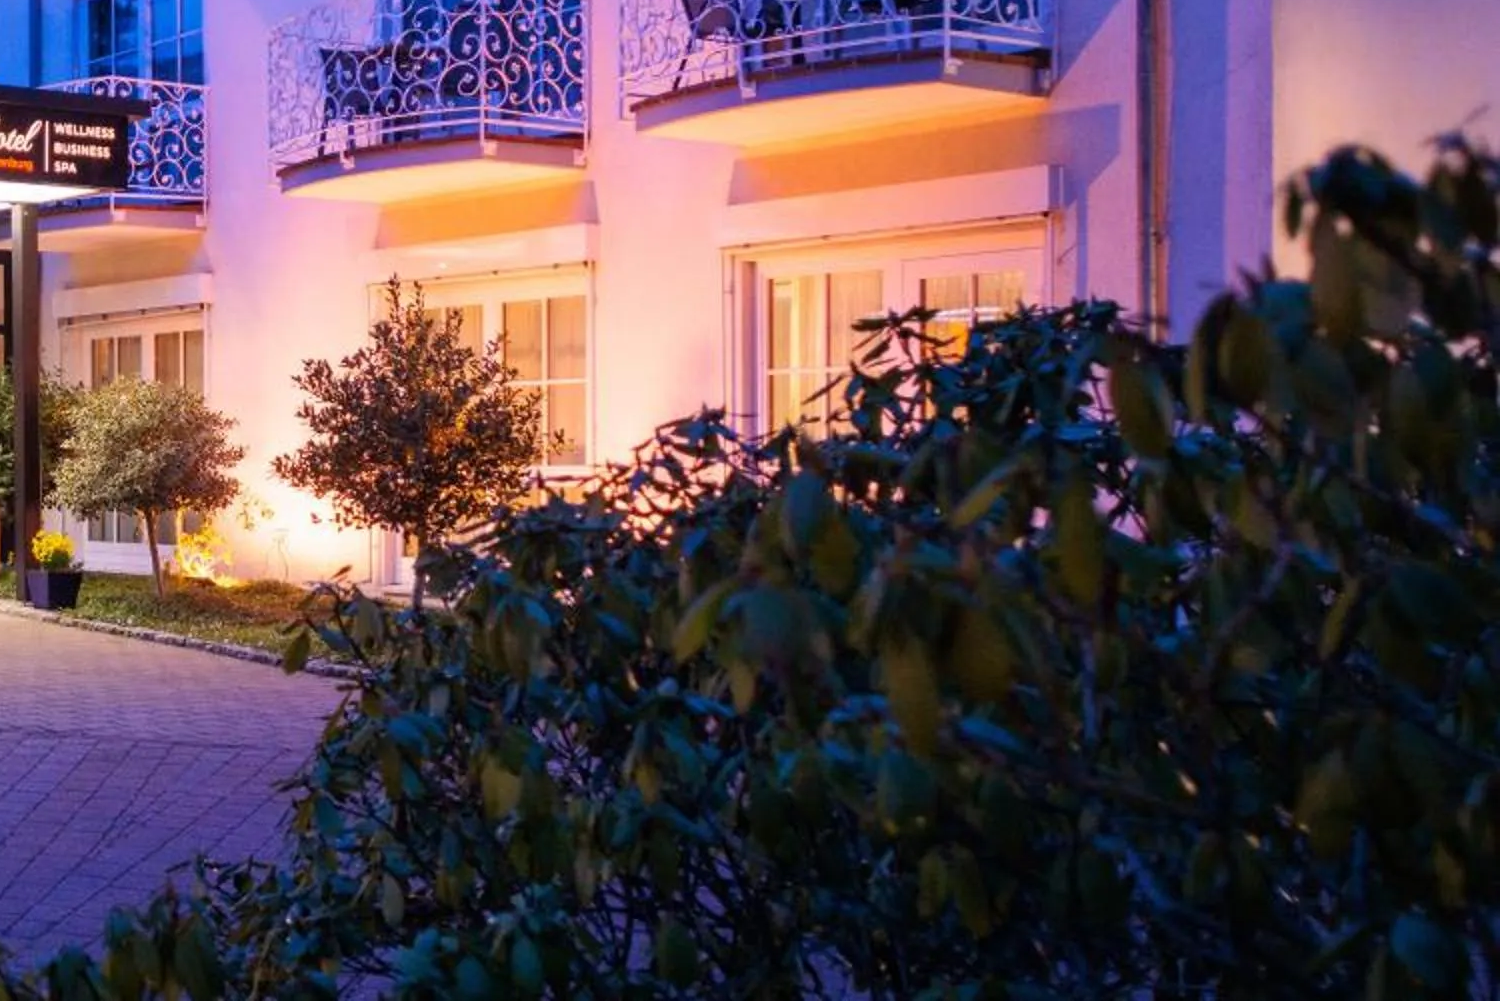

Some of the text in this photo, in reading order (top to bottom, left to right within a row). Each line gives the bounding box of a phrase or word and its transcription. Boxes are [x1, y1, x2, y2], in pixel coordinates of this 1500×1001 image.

[53, 122, 116, 140] WELLNESS
[53, 142, 111, 159] BUSINESS
[53, 160, 78, 175] SPA
